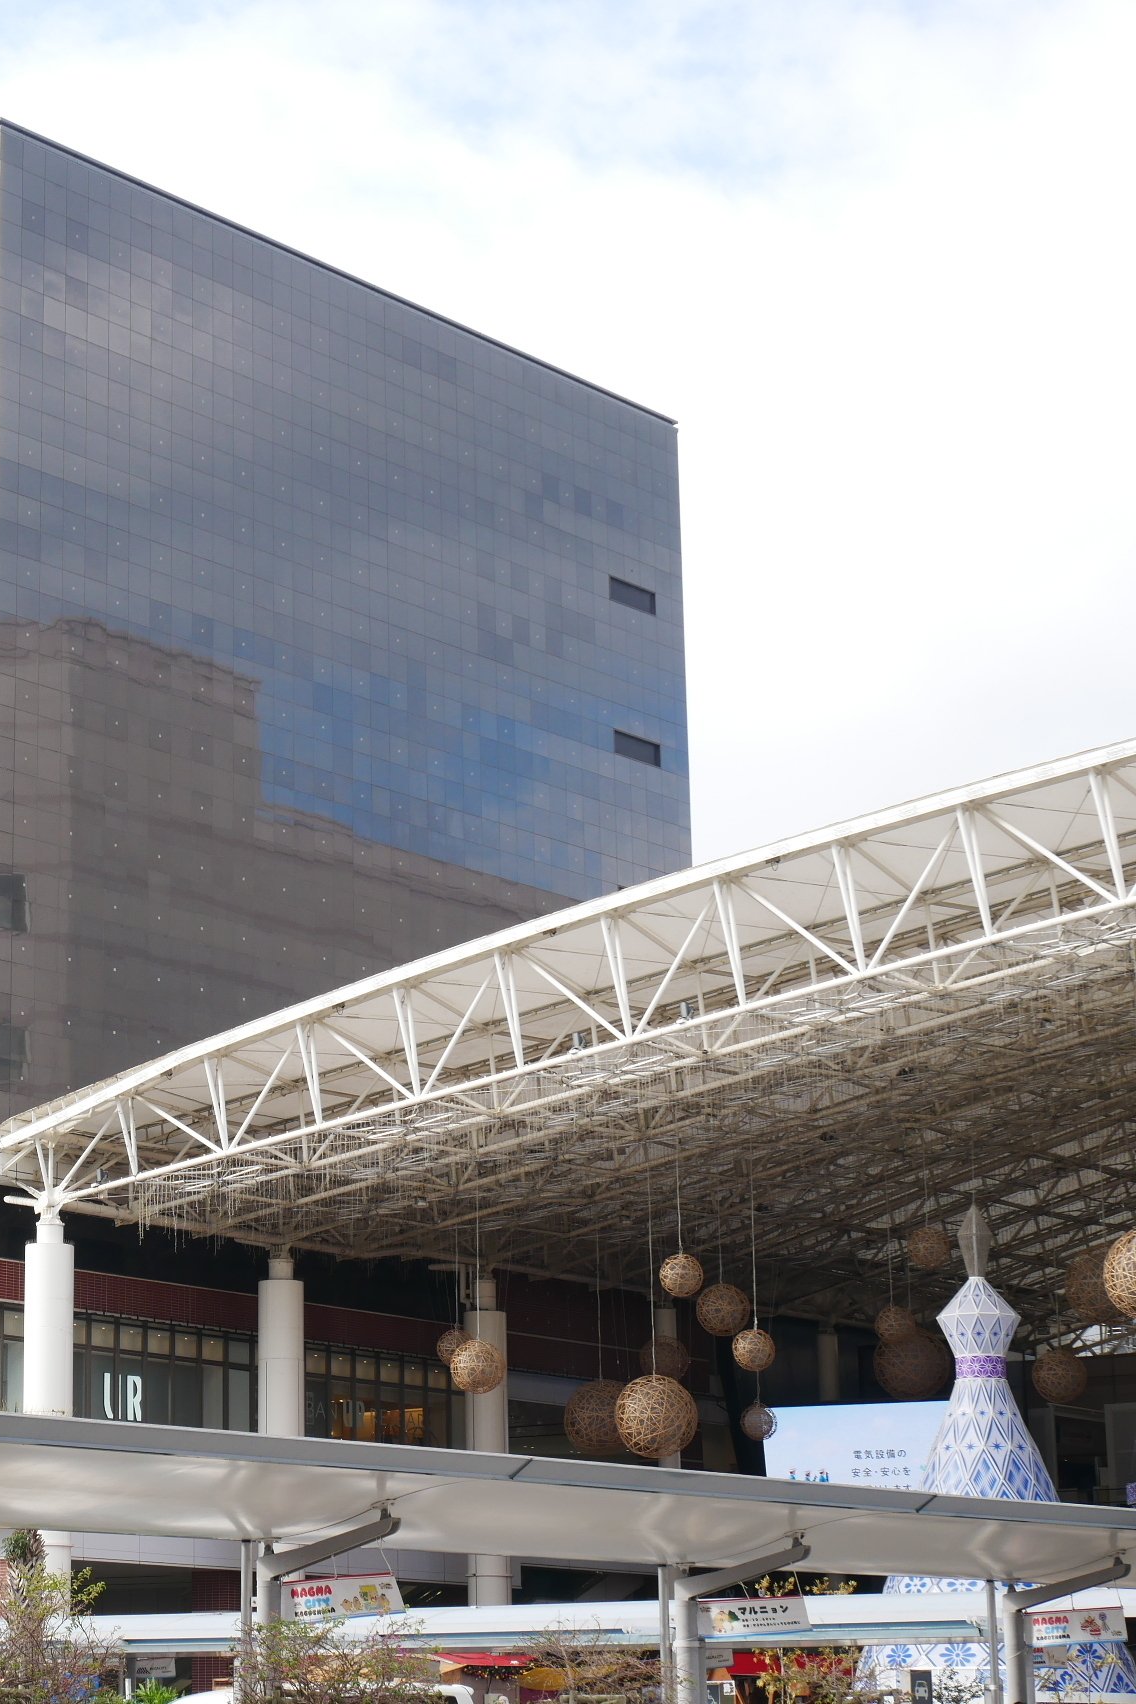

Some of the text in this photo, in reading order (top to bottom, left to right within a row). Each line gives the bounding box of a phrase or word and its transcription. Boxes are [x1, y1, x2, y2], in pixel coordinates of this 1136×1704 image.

[853, 1449, 907, 1460] 電気設備の
[851, 1466, 911, 1478] 安全・安心を
[290, 1585, 333, 1600] MAGMA
[304, 1597, 332, 1610] CITY
[737, 1604, 789, 1617] マルニョン
[1033, 1615, 1070, 1626] MAGMA
